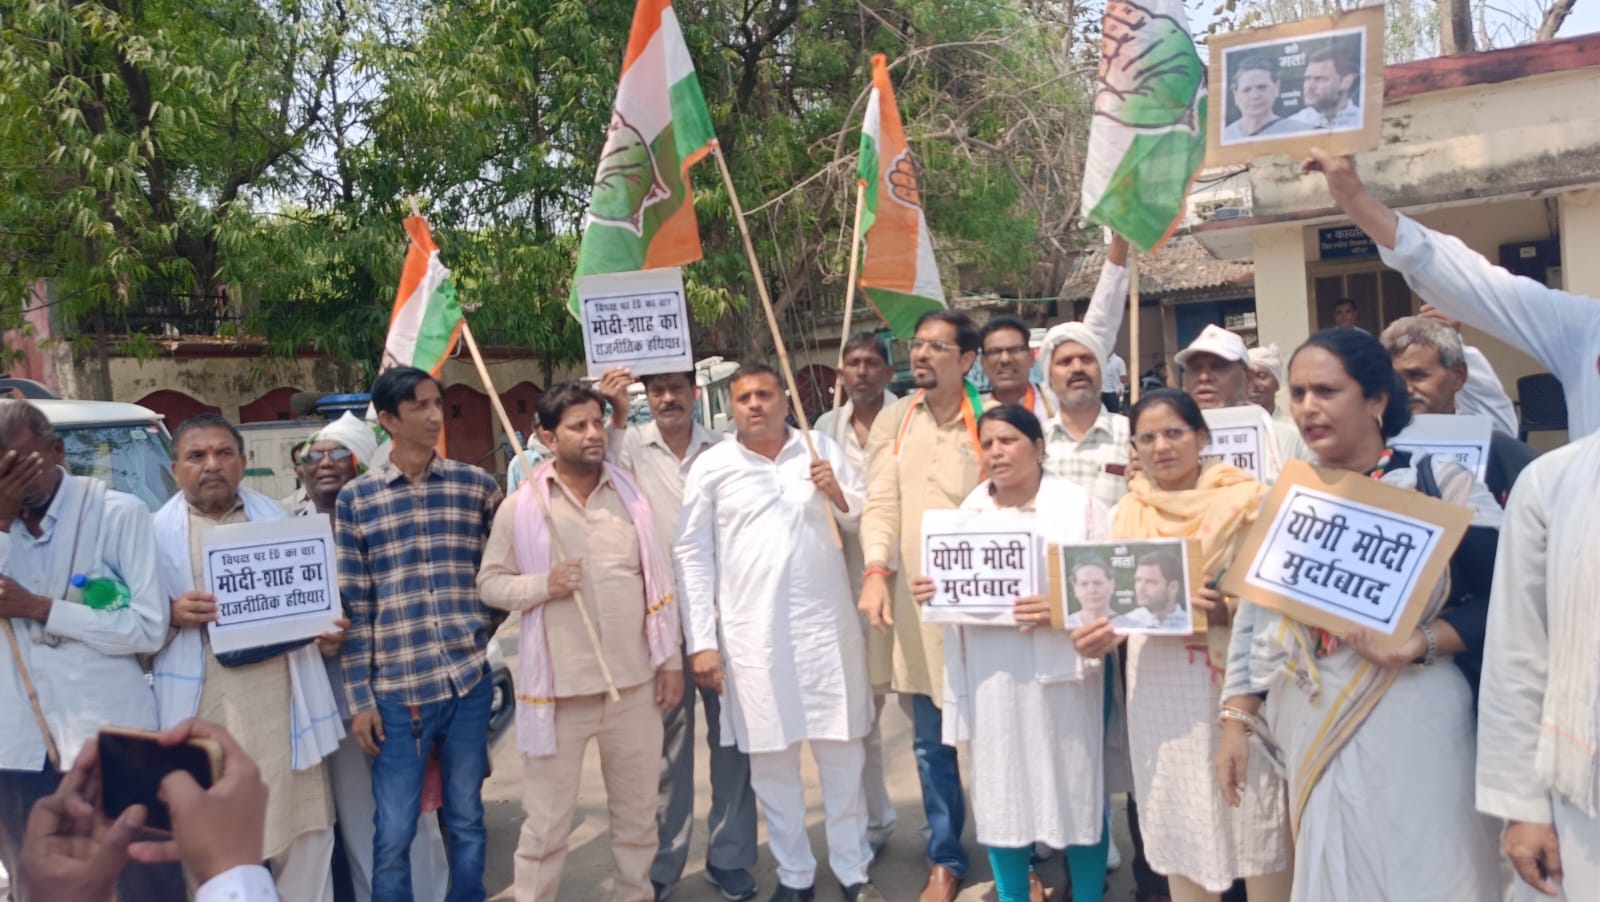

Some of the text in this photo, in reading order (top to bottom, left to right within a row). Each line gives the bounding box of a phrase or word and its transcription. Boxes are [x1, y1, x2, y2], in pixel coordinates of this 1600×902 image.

[592, 313, 678, 336] मोदी-शाह का
[594, 336, 680, 355] राजनीतिक हथियार
[1231, 451, 1255, 470] का
[1287, 505, 1416, 573] योगी मोदी
[222, 546, 316, 566] विपक्ष पर ED का वार
[931, 540, 1026, 570] योगी मोदी
[216, 562, 323, 593] मोदी-शाह का
[941, 572, 1022, 604] मुर्दाबाद
[1281, 550, 1391, 605] मुर्दाबाद
[220, 588, 325, 617] राजनीतिक हथियार
